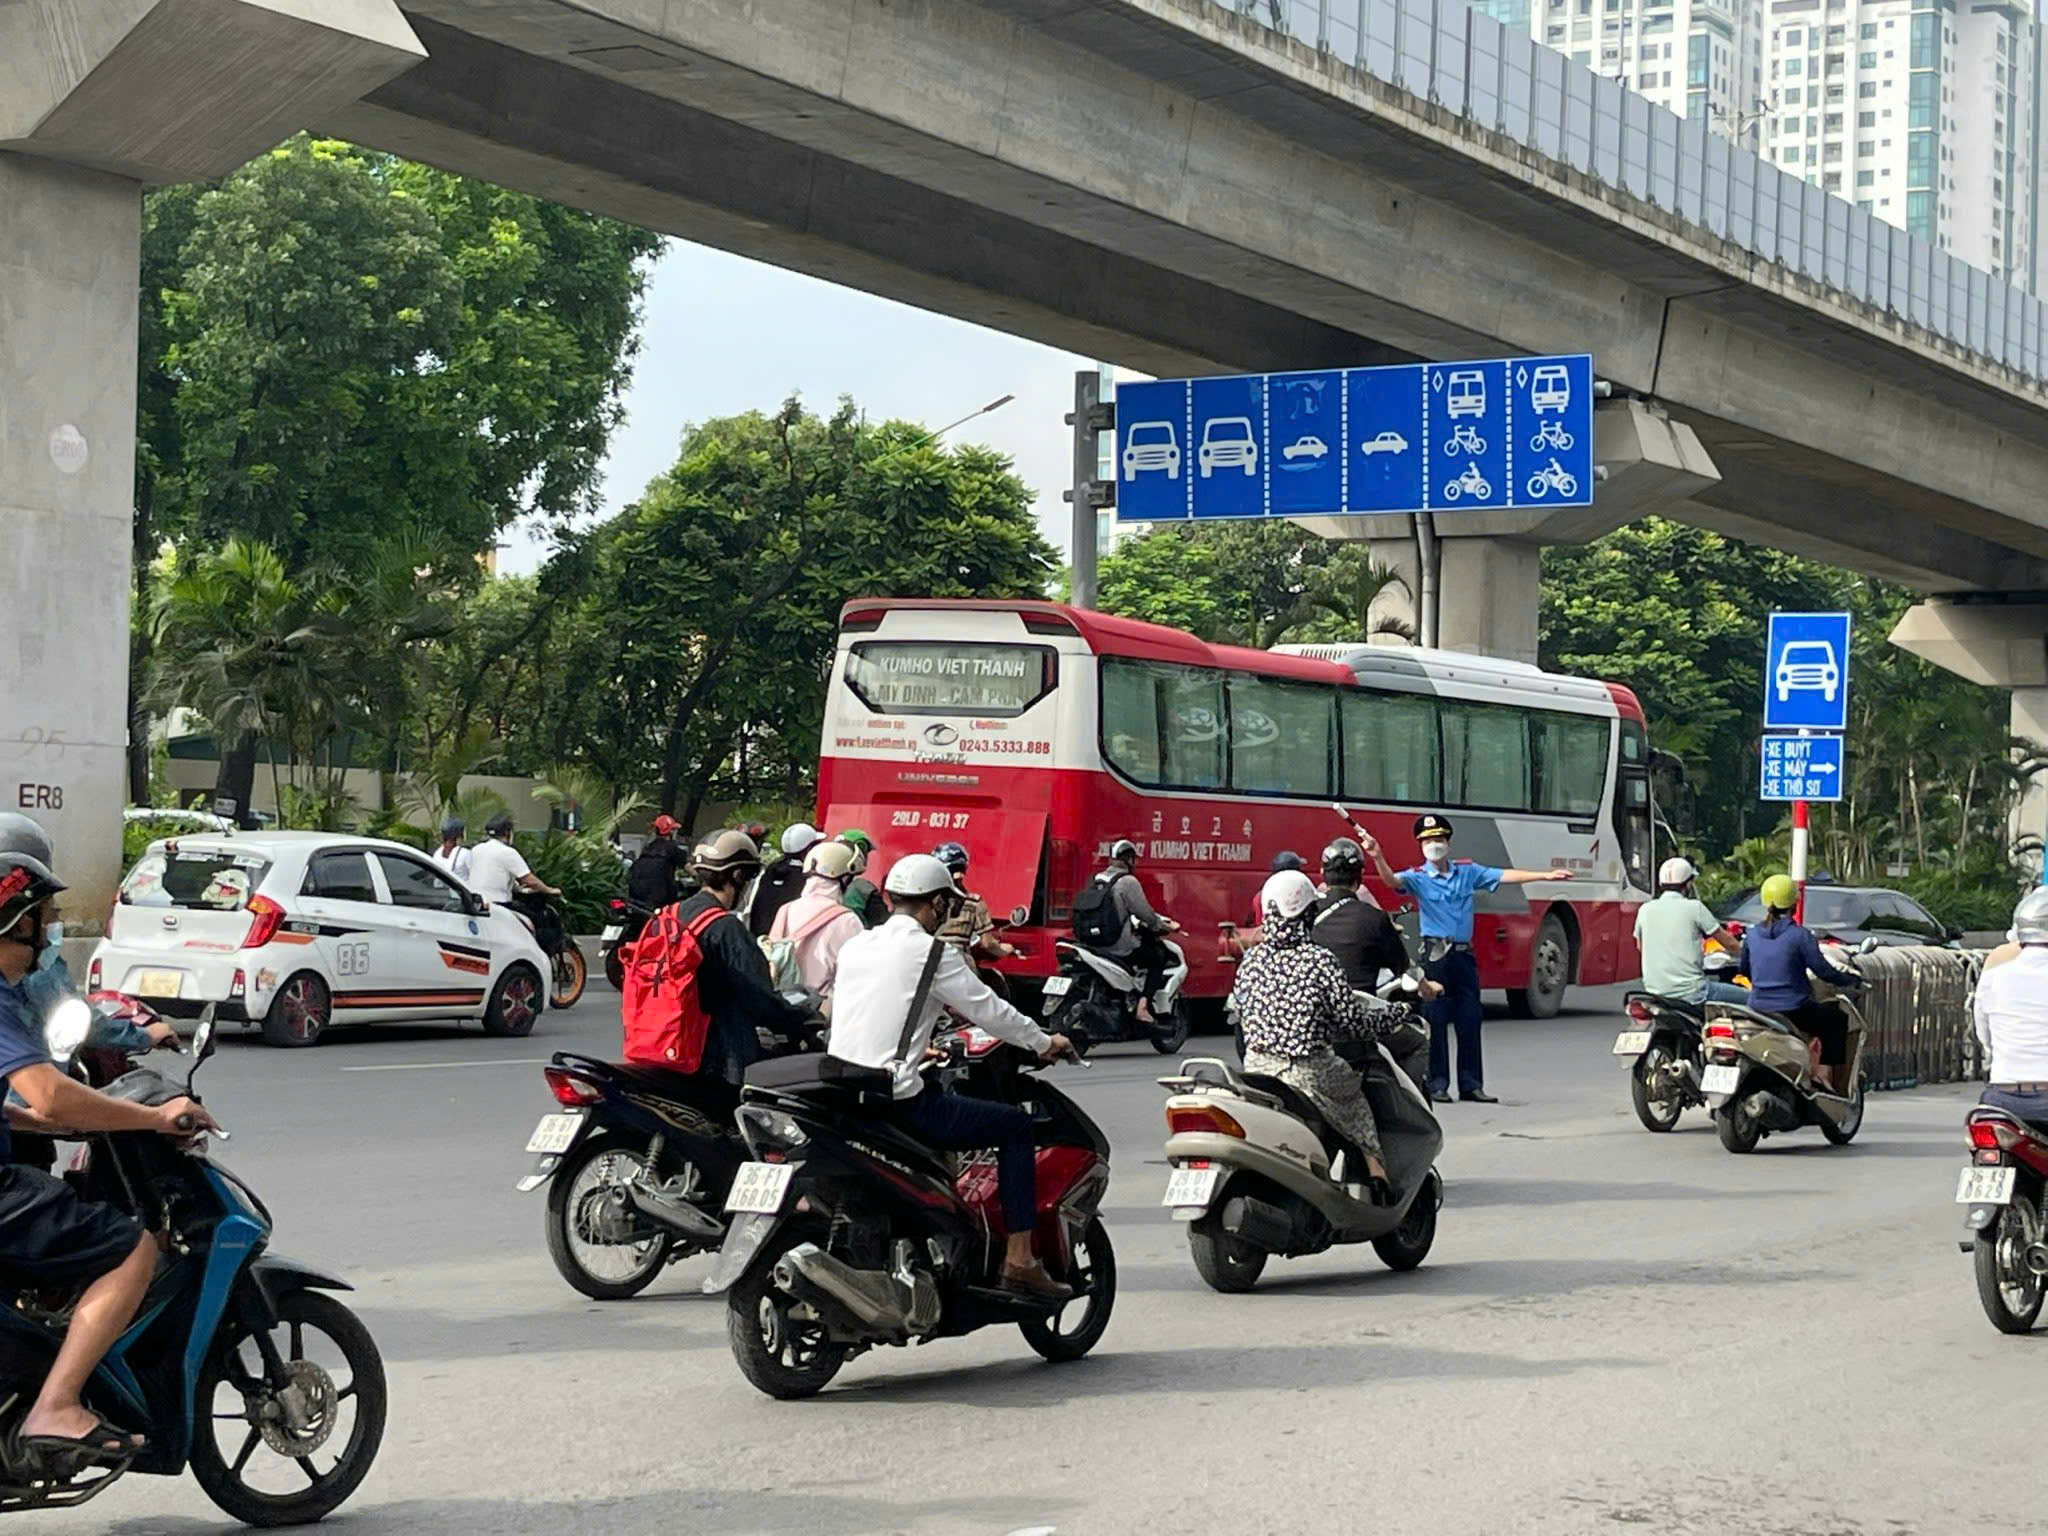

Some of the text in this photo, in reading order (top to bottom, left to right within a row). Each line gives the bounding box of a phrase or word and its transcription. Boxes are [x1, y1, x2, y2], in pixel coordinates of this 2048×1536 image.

[881, 656, 1025, 678] KUMHO VIET THANH
[959, 739, 1051, 755] 0243.5333.888
[19, 783, 63, 810] ER8
[1150, 840, 1251, 862] KUMHO VIET THANH
[337, 943, 370, 976] 86
